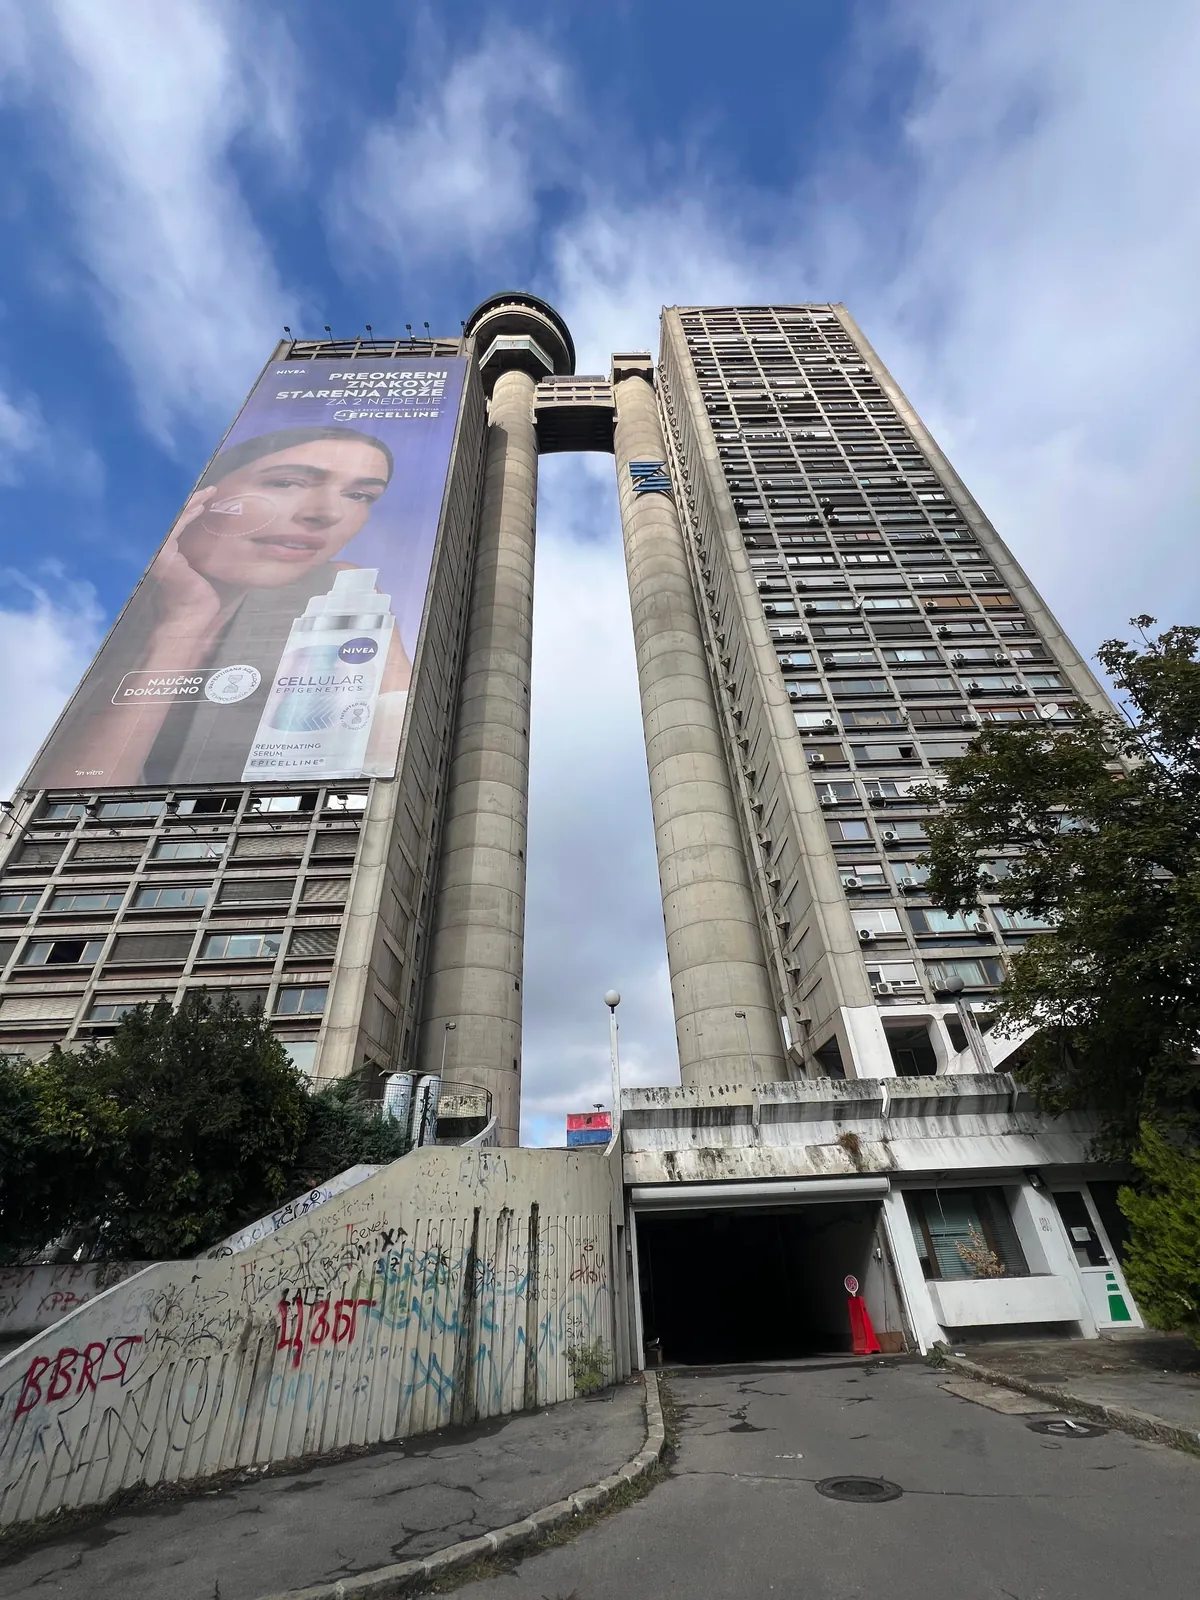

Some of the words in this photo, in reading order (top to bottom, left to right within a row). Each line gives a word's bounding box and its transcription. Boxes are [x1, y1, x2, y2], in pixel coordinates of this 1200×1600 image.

[328, 372, 447, 380] PREOKRENI
[346, 380, 445, 388] ZNAKOVE
[275, 389, 380, 399] STARENJA
[387, 387, 444, 397] KOŽE
[325, 398, 347, 406] ZA
[352, 398, 362, 406] 2
[342, 647, 375, 655] NIVEA
[147, 675, 204, 687] NAUČNO
[277, 675, 363, 686] CELLULAR
[123, 686, 200, 697] DOKAZANO
[275, 685, 364, 694] EPIGENETICS
